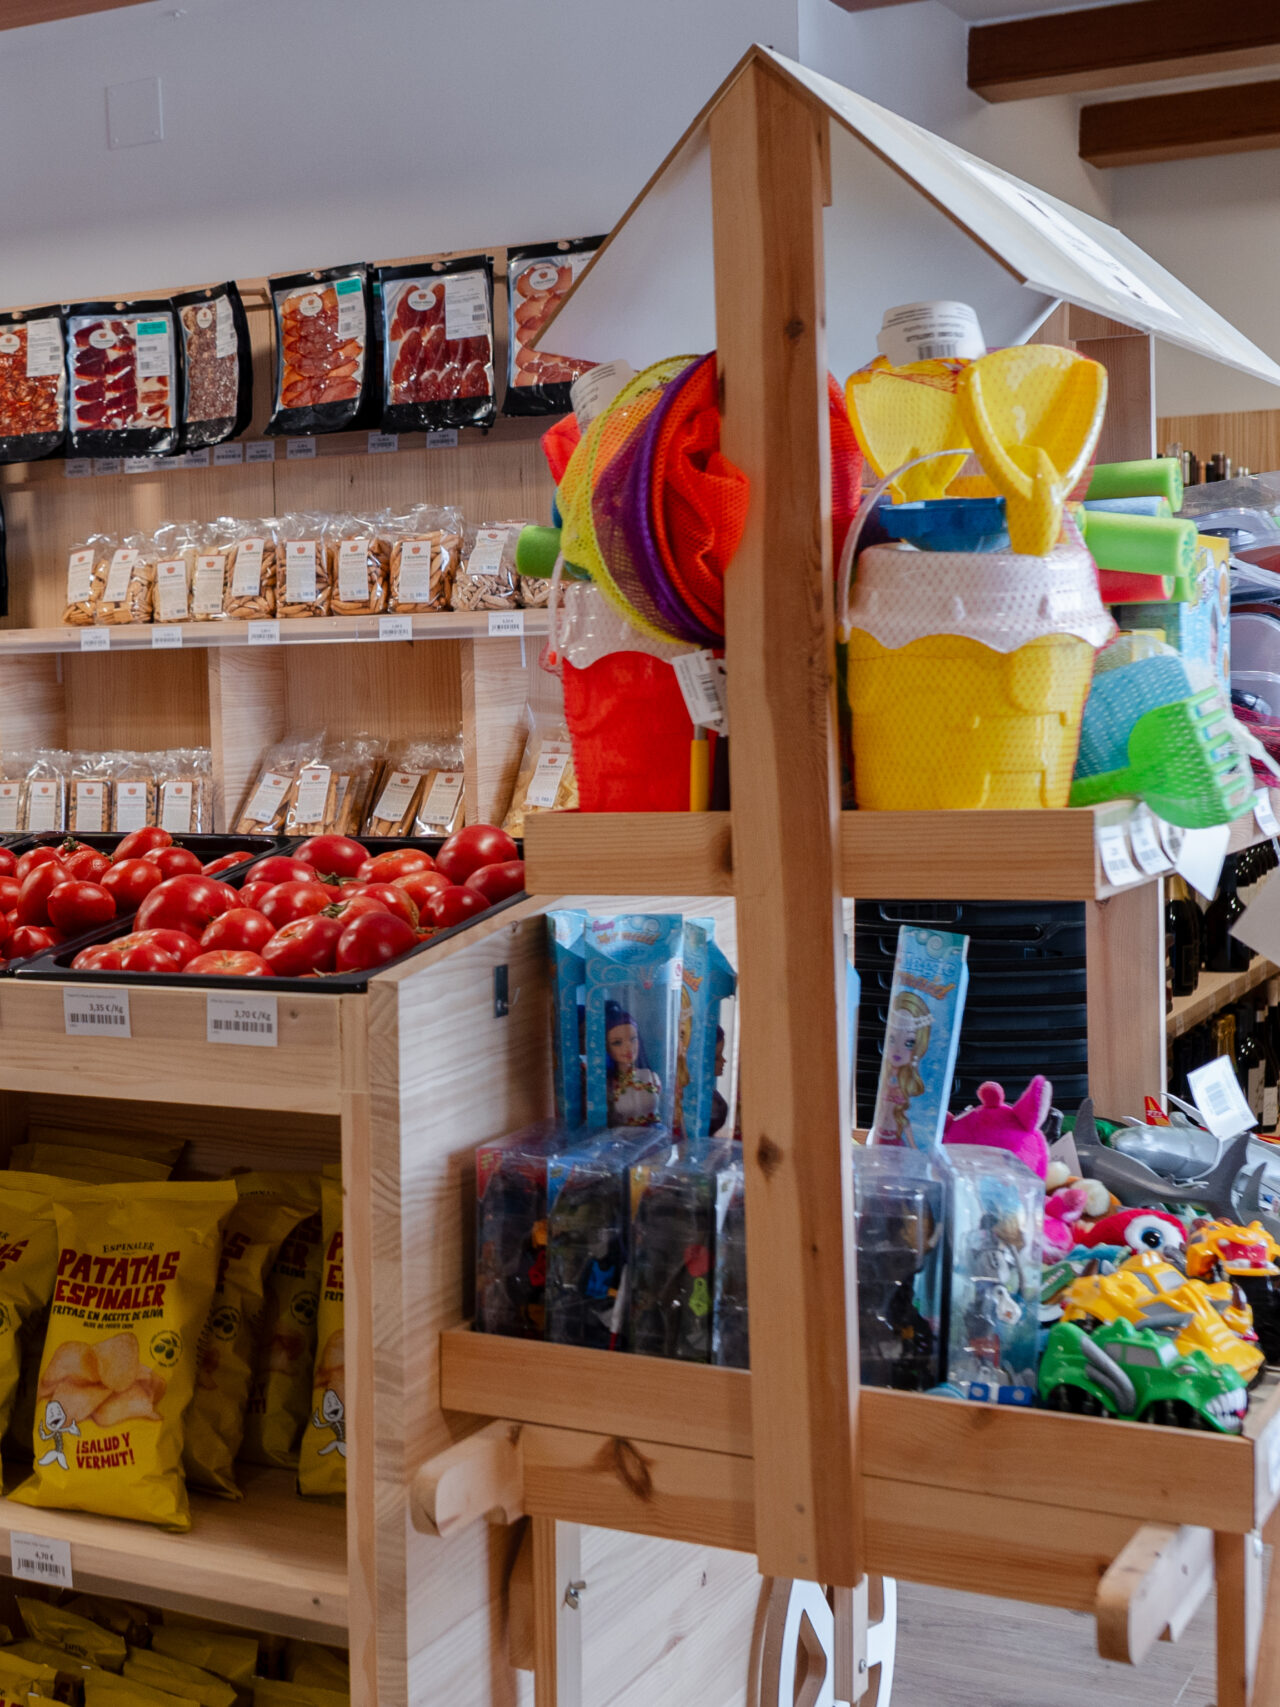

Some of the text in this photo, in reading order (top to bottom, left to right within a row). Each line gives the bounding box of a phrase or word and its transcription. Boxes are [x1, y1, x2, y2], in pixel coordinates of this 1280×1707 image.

[234, 1009, 250, 1018] 3,70
[103, 1242, 155, 1254] ESPINALER
[57, 1248, 180, 1287] PATATAS
[54, 1279, 166, 1311] ESPINALER
[88, 1309, 100, 1321] EN
[101, 1310, 131, 1323] ACEITE
[76, 1432, 130, 1455] ¡SALUD Y
[76, 1448, 135, 1470] VERMUT!
[50, 1554, 54, 1562] €
